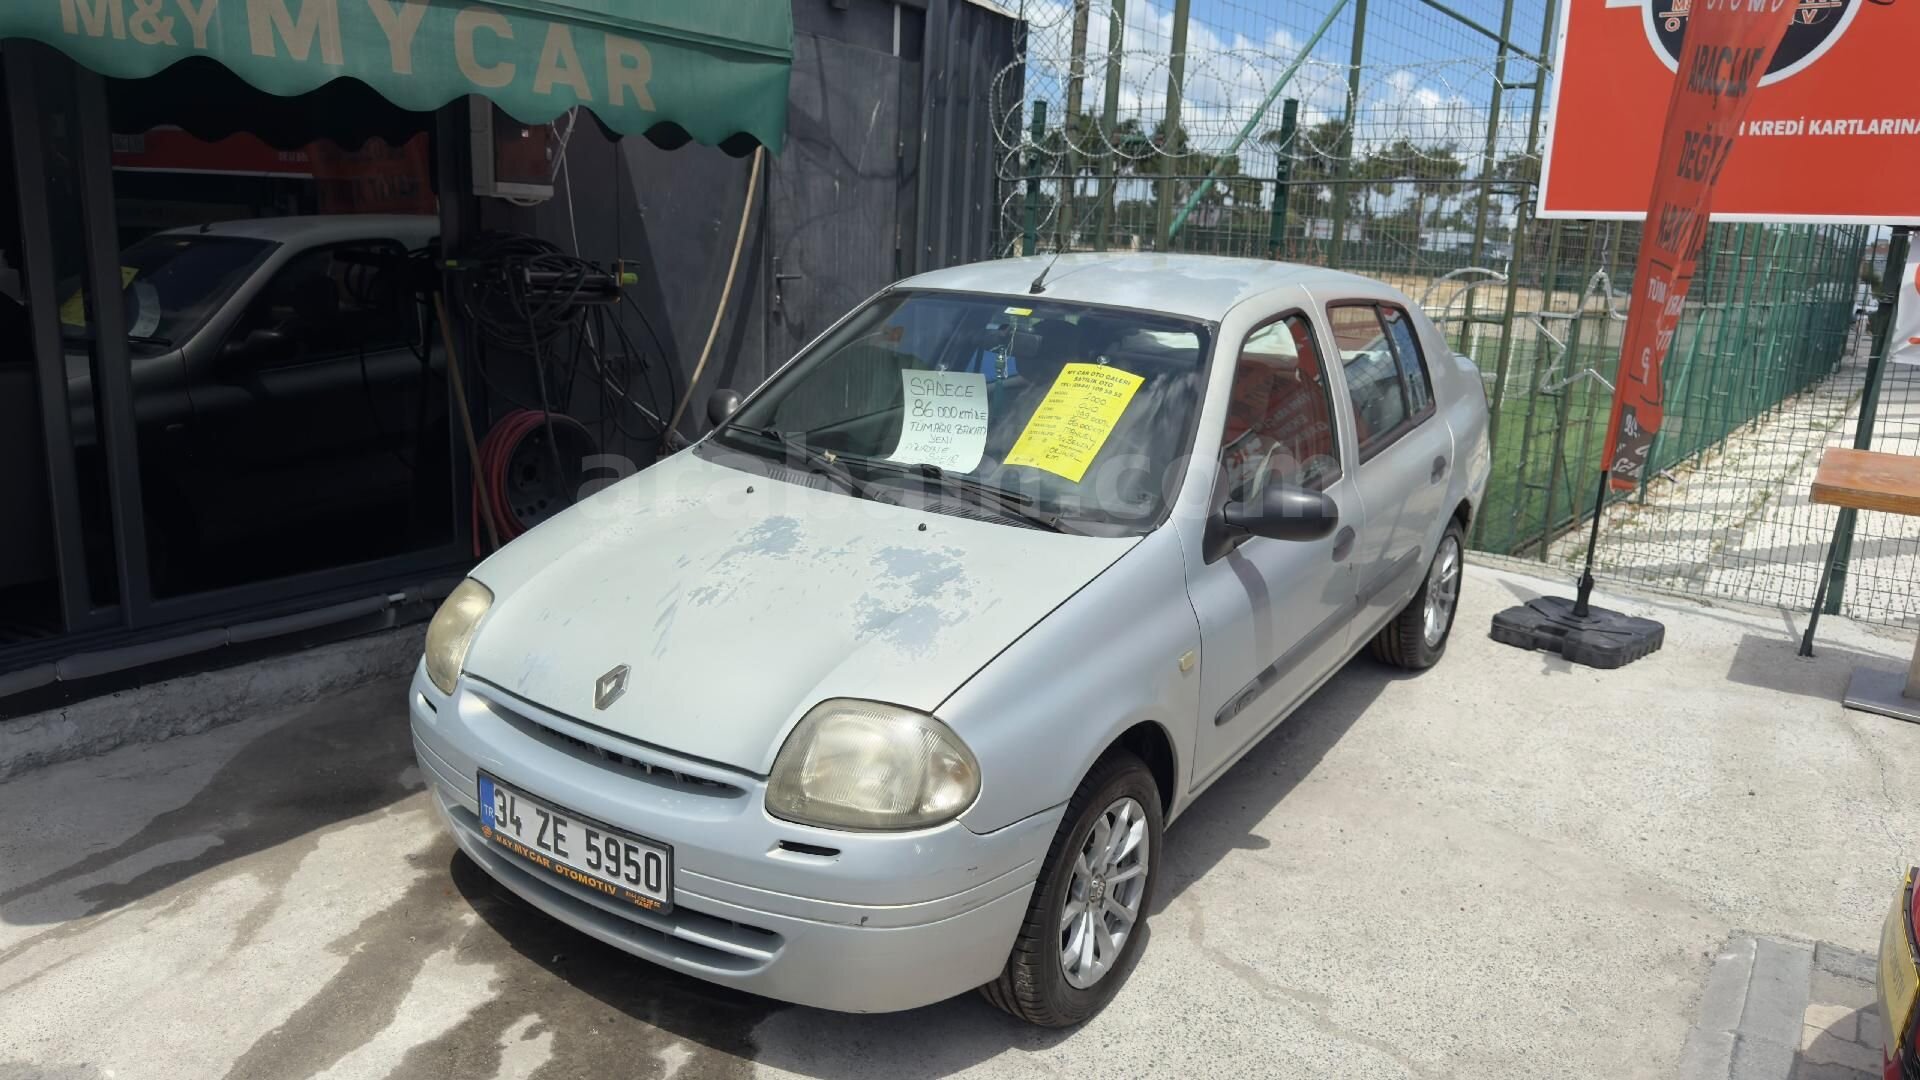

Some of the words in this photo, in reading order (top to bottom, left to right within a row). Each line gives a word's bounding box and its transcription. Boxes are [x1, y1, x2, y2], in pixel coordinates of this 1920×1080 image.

[60, 0, 218, 50] M&Y
[245, 0, 658, 113] MYCAR
[1749, 116, 1806, 136] KREDİ
[910, 377, 977, 398] SADECE
[911, 399, 934, 418] 86
[483, 804, 494, 819] TR
[494, 788, 522, 837] 34
[535, 807, 569, 859] ZE
[585, 827, 662, 894] 5950
